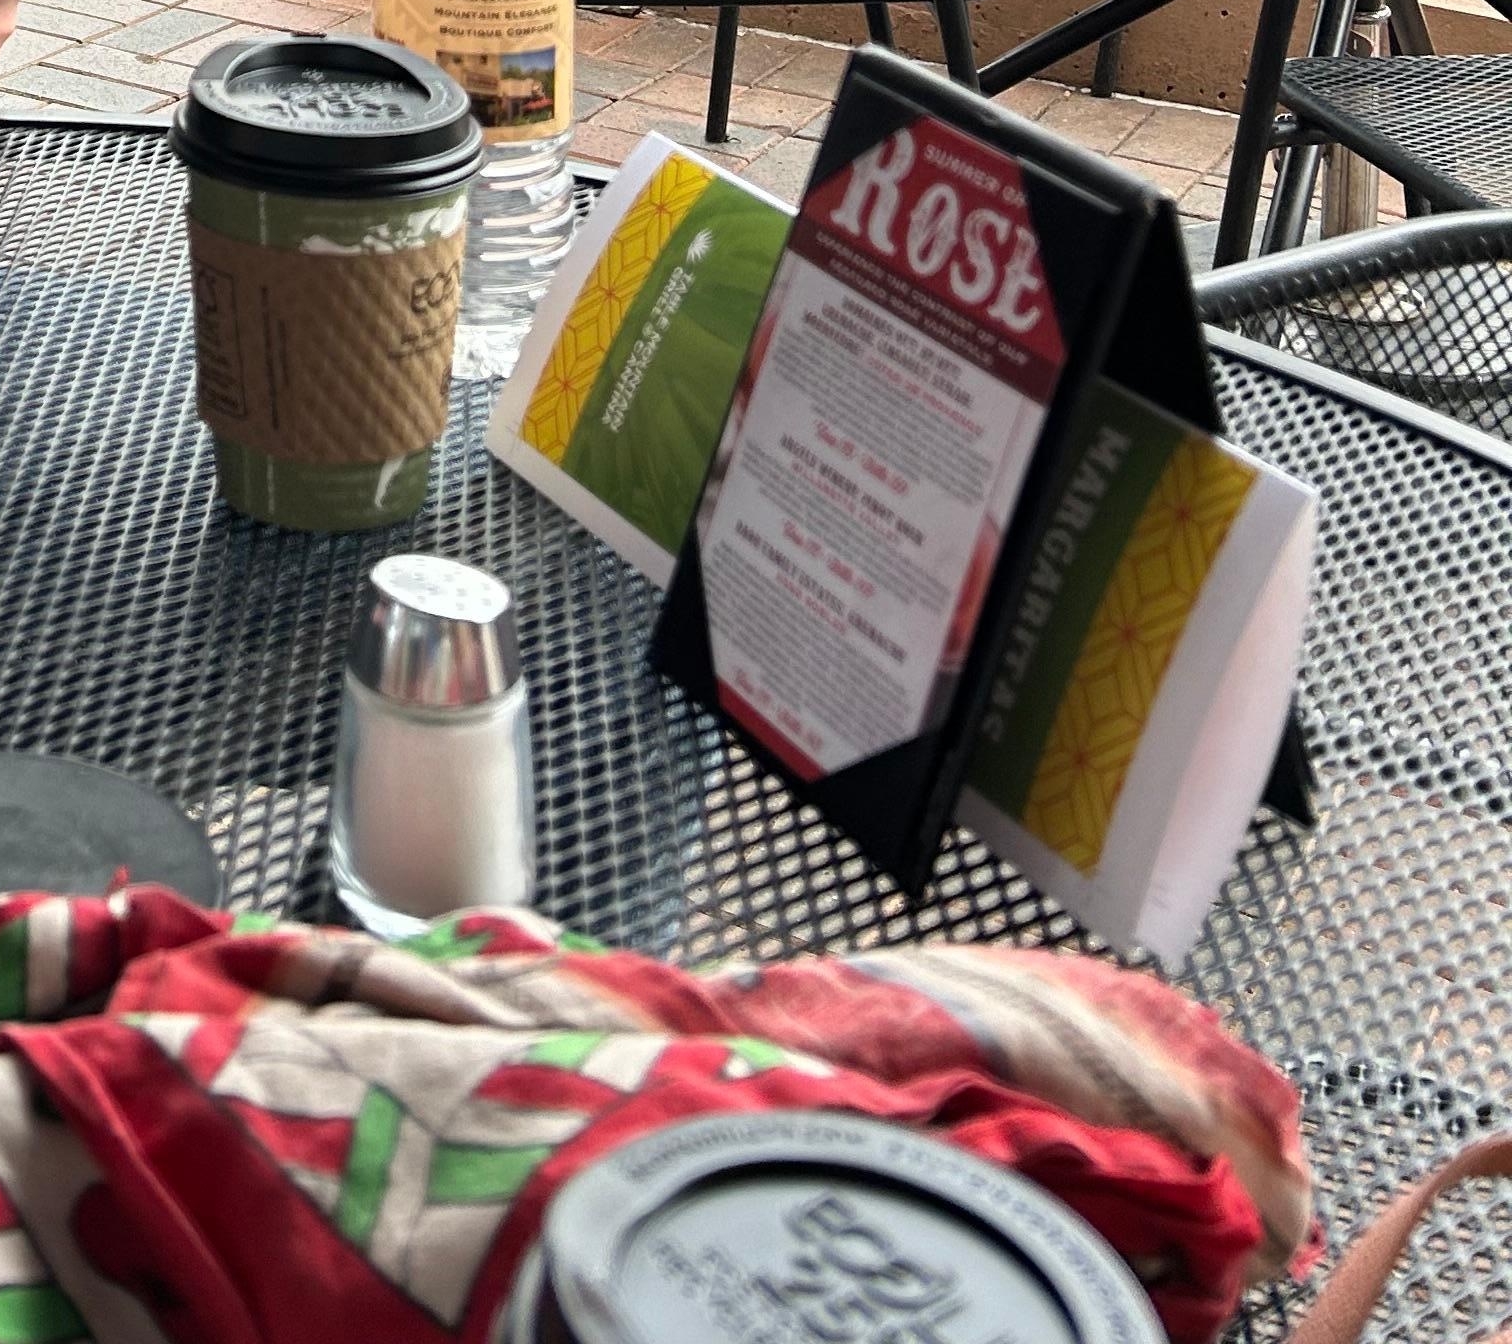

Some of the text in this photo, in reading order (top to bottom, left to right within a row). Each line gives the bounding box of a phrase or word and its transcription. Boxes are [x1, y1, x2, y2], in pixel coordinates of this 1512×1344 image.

[434, 8, 500, 19] MOUNTAIN
[440, 25, 502, 37] BOUTIQUE
[650, 266, 684, 317] GRILL
[601, 339, 645, 425] CANTINA
[610, 272, 696, 432] TABLE MOUNTAIN
[982, 424, 1133, 743] MARGARITAS
